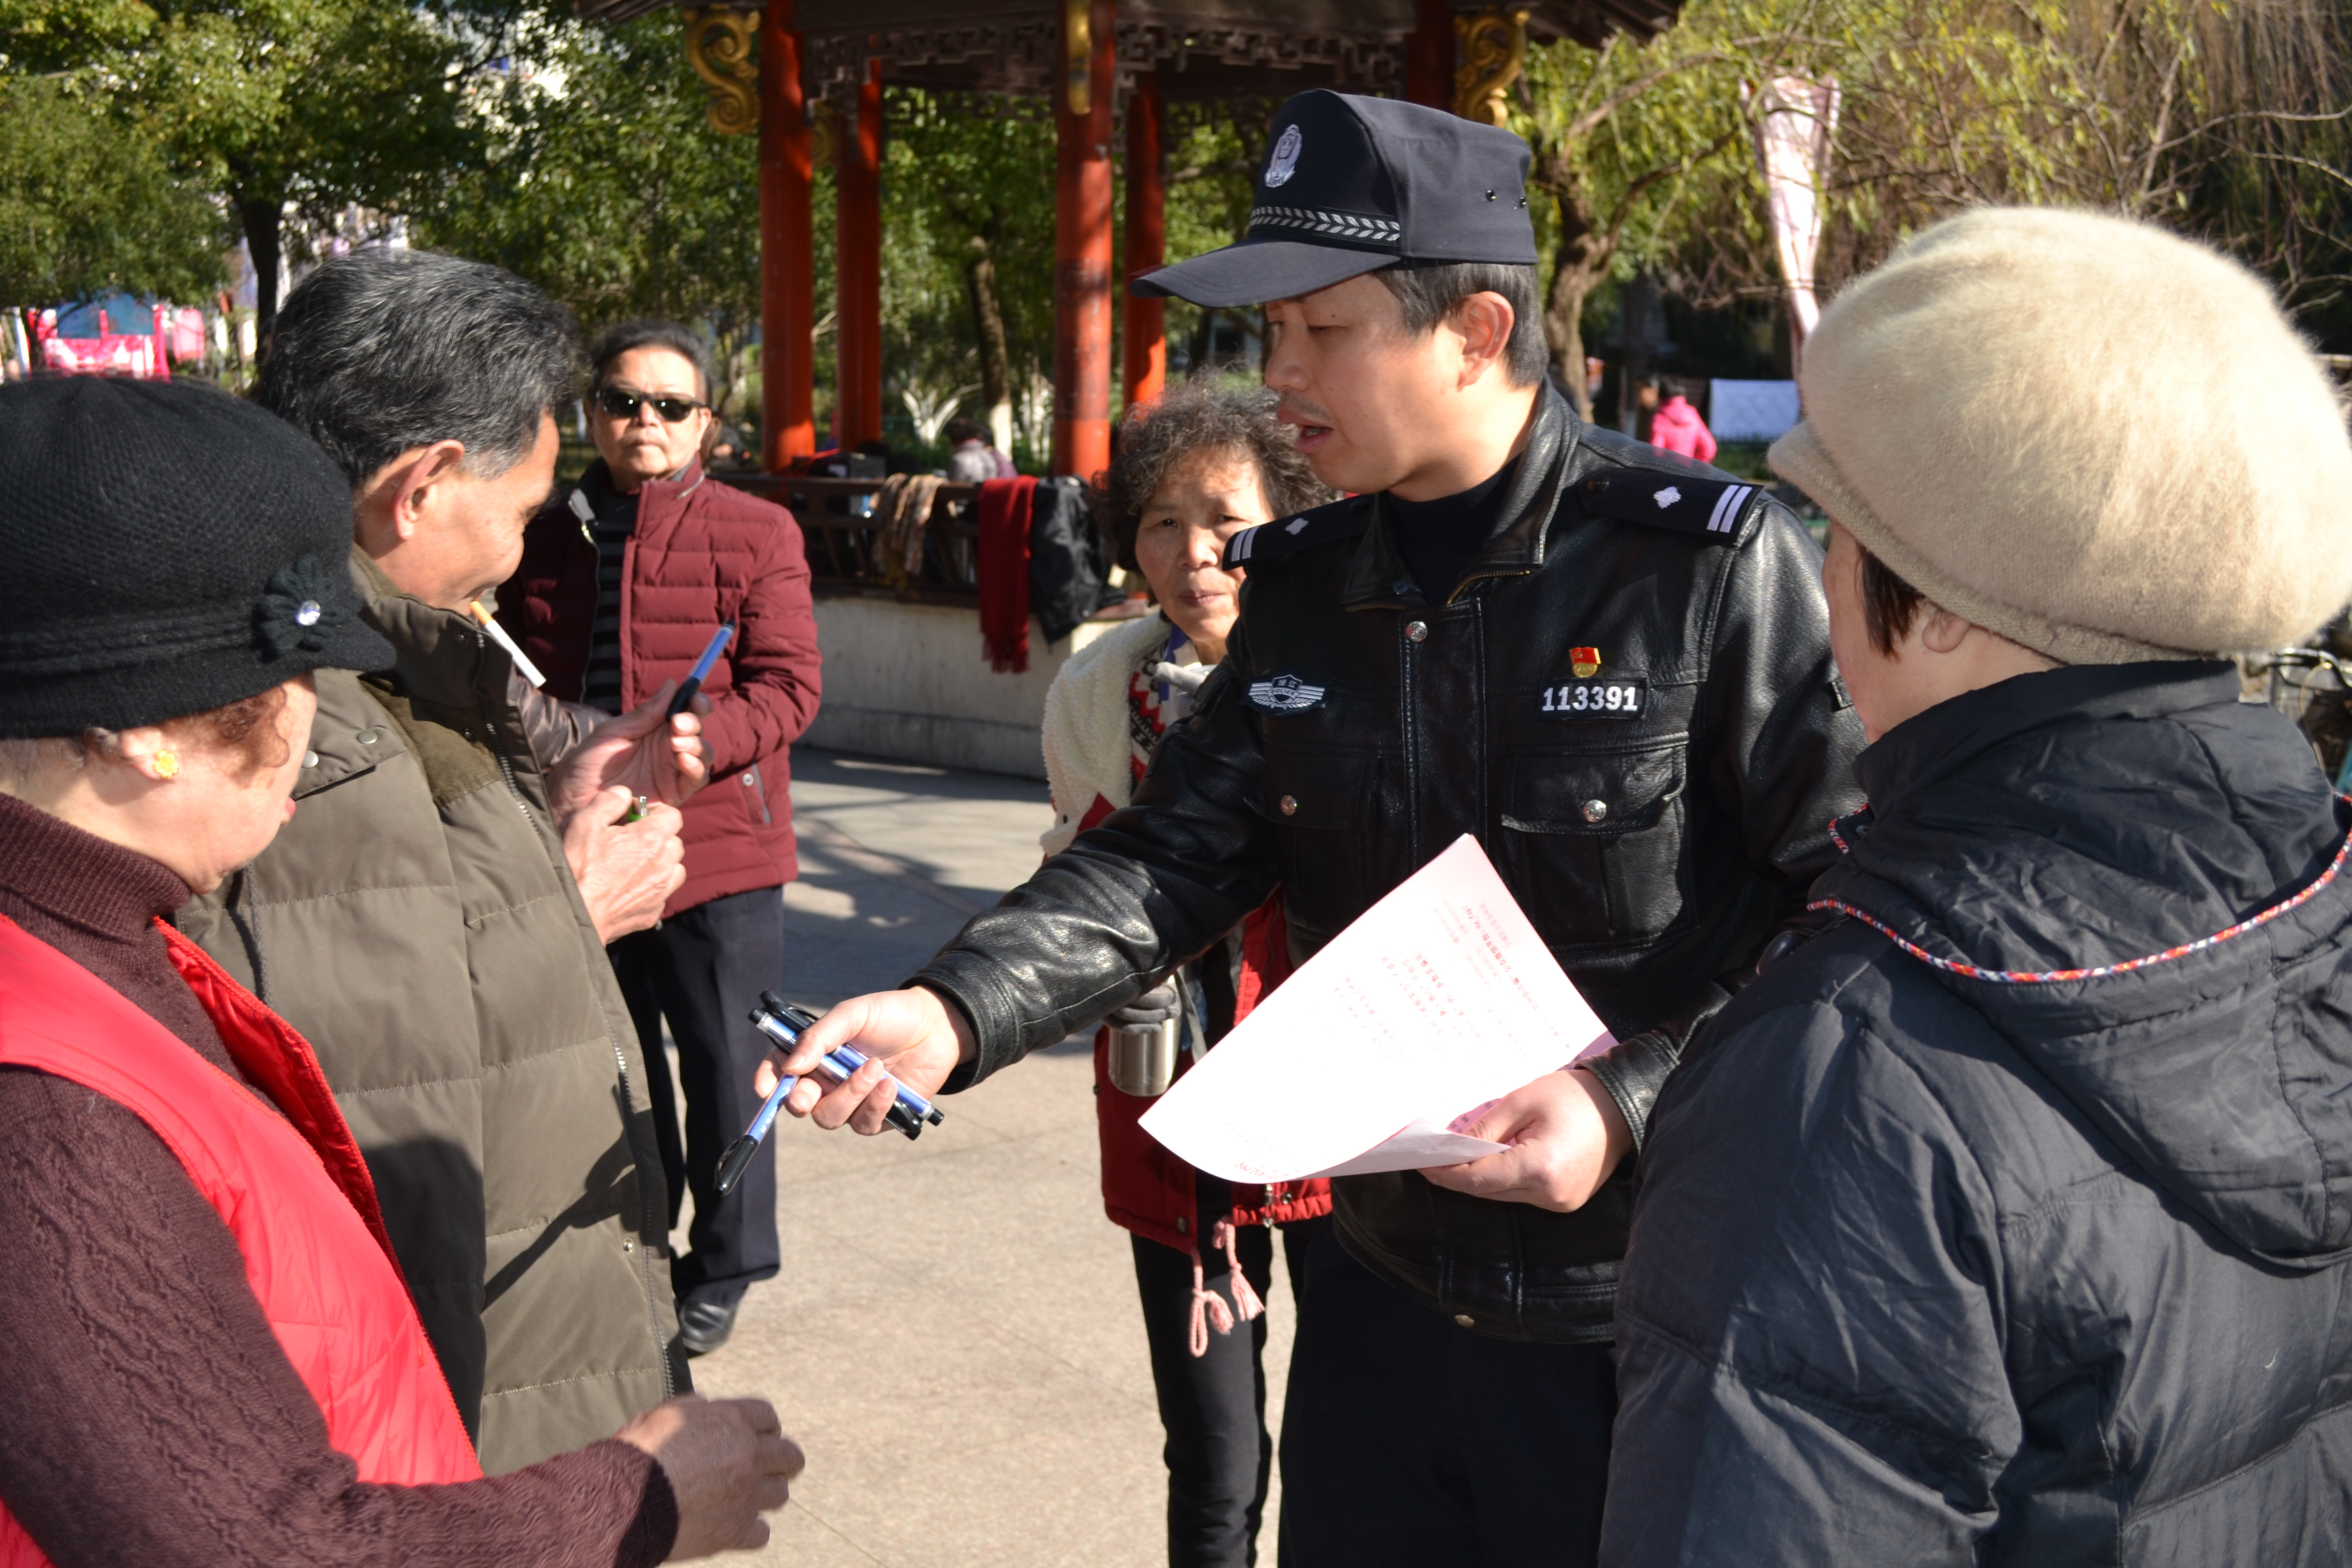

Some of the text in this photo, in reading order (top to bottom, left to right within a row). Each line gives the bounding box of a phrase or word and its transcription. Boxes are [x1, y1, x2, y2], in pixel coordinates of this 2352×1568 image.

[1277, 679, 1297, 688] 浙江
[1271, 688, 1295, 696] POLICE
[1542, 686, 1638, 711] 113391
